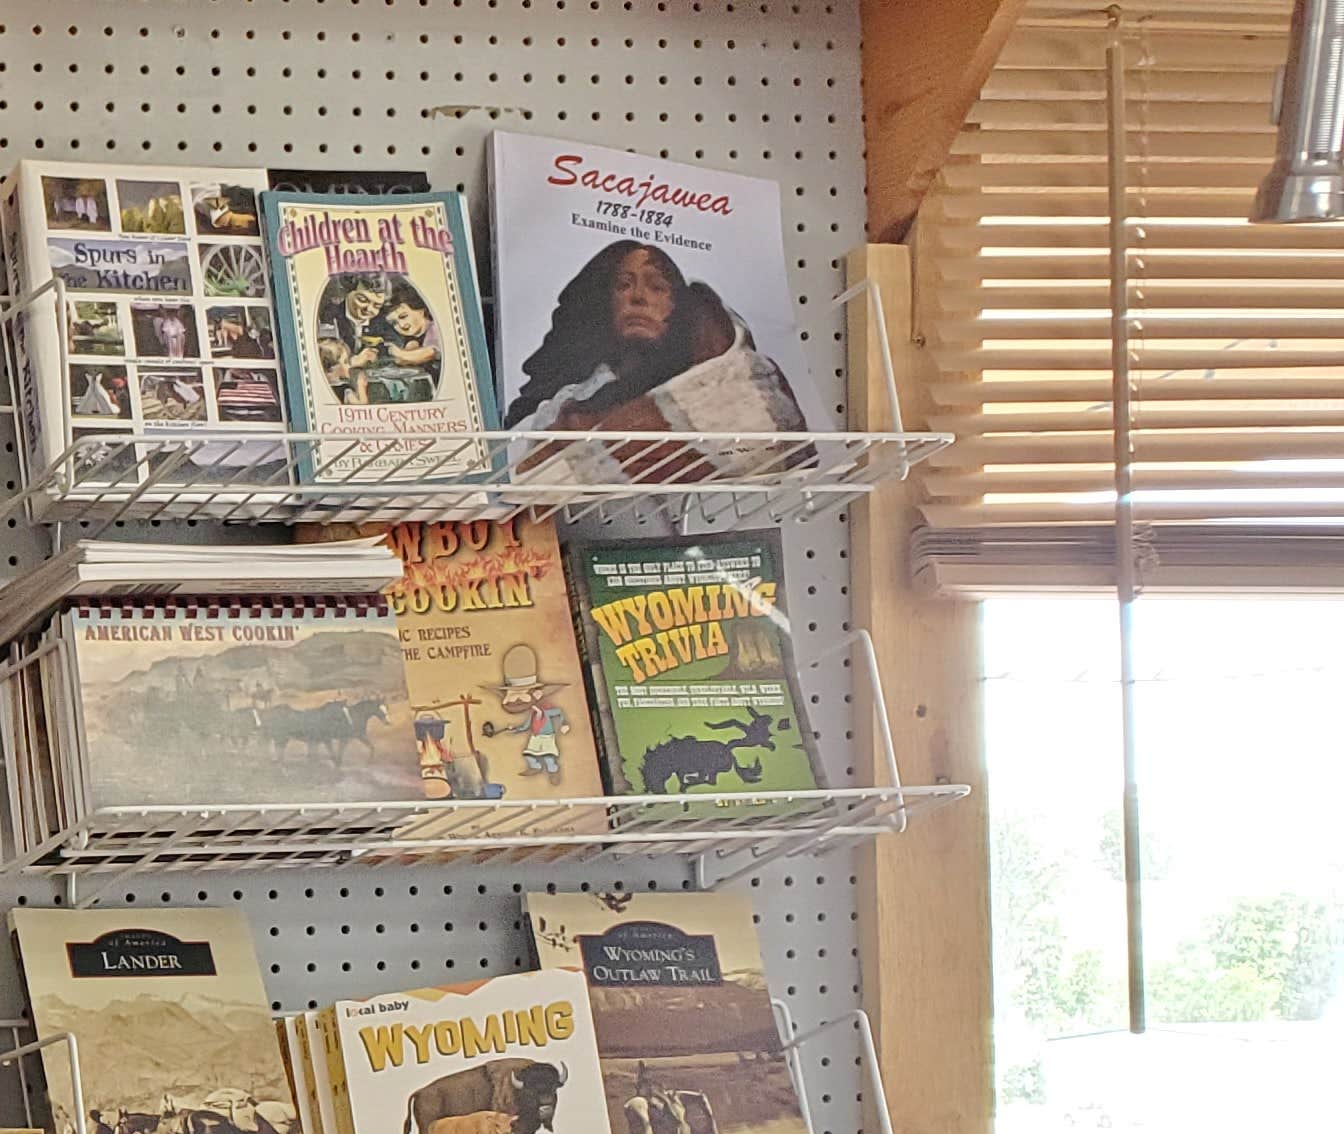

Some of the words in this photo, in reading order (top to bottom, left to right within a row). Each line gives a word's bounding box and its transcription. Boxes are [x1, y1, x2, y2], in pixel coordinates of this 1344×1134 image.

[547, 155, 735, 216] Sacajawea
[595, 200, 673, 228] 1788-1884
[277, 211, 372, 257] Children
[377, 213, 405, 245] at
[409, 216, 455, 254] the
[571, 213, 627, 236] Examine
[630, 227, 651, 241] the
[654, 231, 712, 251] Evidence
[74, 242, 137, 267] Spurs
[148, 248, 165, 265] in
[323, 241, 409, 276] Hearth
[96, 269, 188, 292] Kitchen
[338, 408, 373, 423] 19TH
[376, 407, 448, 421] CENTURY
[590, 582, 777, 646] WYOMING
[84, 624, 173, 642] AMERICAN
[179, 622, 225, 641] WEST
[232, 623, 301, 642] COOKIN'
[418, 626, 471, 641] RECIPES
[427, 644, 492, 660] CAMPFIRE
[615, 621, 729, 684] TRIVIA
[101, 951, 182, 970] LANDER
[604, 945, 696, 963] WYOMING'S
[592, 965, 662, 984] OUTLAW
[666, 965, 716, 983] TRAIL
[378, 999, 410, 1016] baby
[358, 1000, 575, 1073] WYOMING
